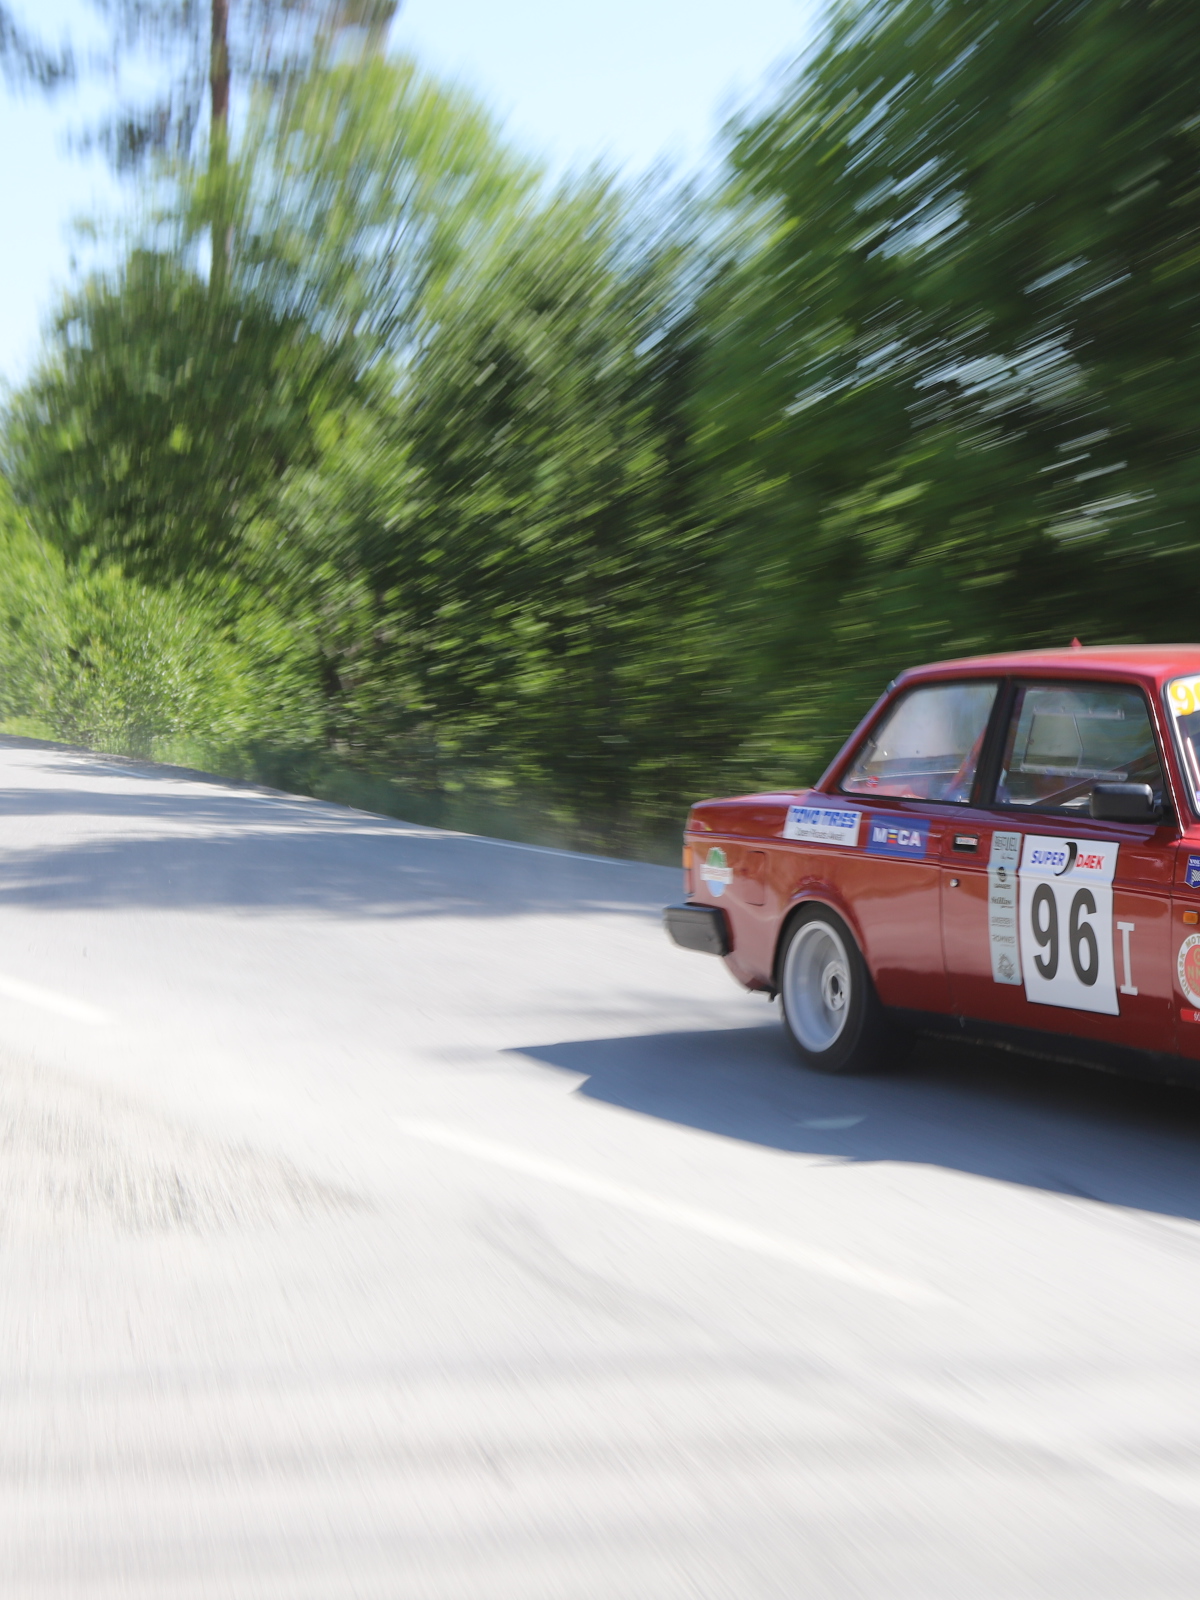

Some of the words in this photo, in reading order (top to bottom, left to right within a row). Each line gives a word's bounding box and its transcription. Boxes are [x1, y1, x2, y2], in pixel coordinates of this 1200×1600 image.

[788, 808, 822, 825] TOYO
[822, 811, 858, 829] TIRES
[1031, 850, 1066, 866] SUPER
[1031, 882, 1099, 987] 96
[1117, 921, 1139, 996] I
